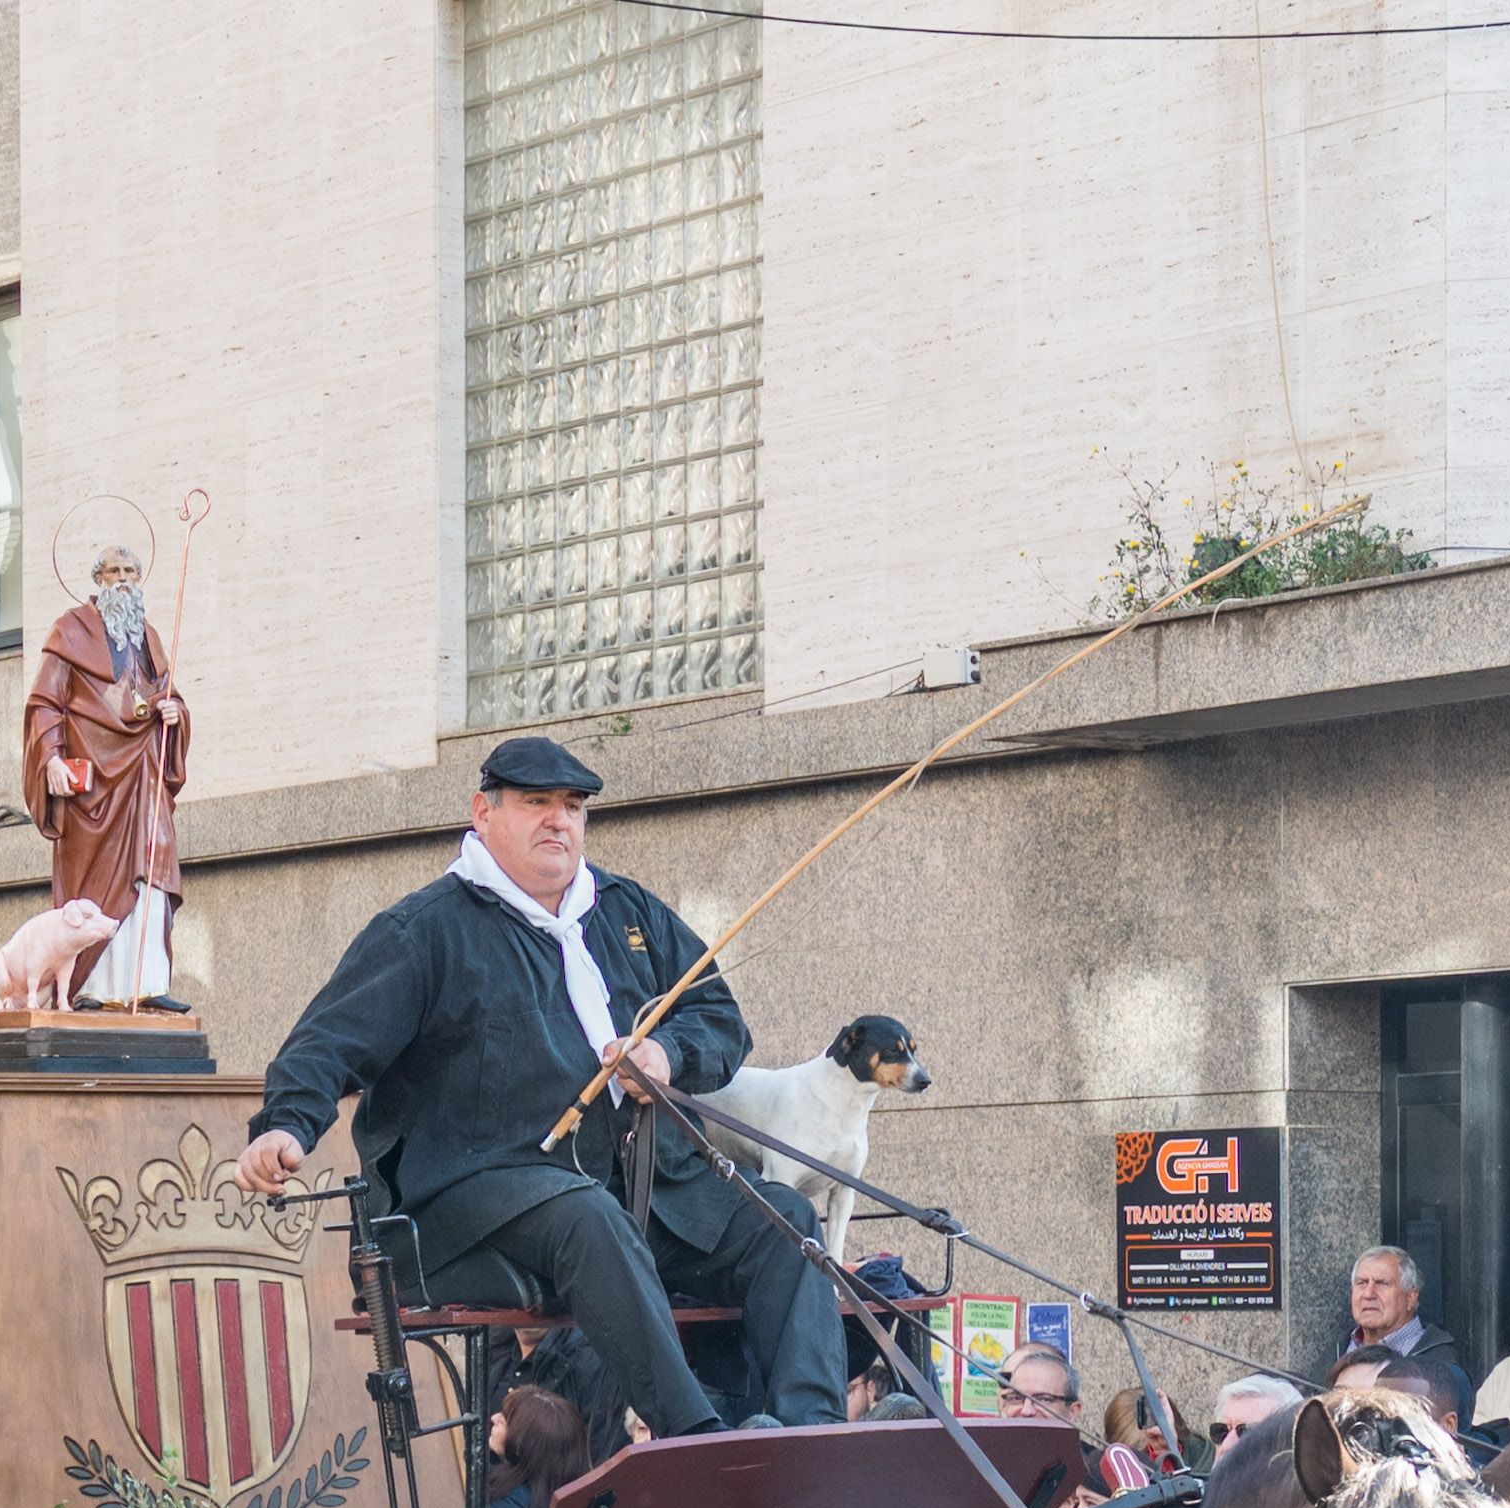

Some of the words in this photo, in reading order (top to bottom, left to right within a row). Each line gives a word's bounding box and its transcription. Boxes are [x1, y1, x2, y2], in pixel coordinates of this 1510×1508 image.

[1124, 1198, 1208, 1225] TRADUCCIÓ
[1209, 1204, 1216, 1223] I
[1216, 1202, 1273, 1223] SERVEIS
